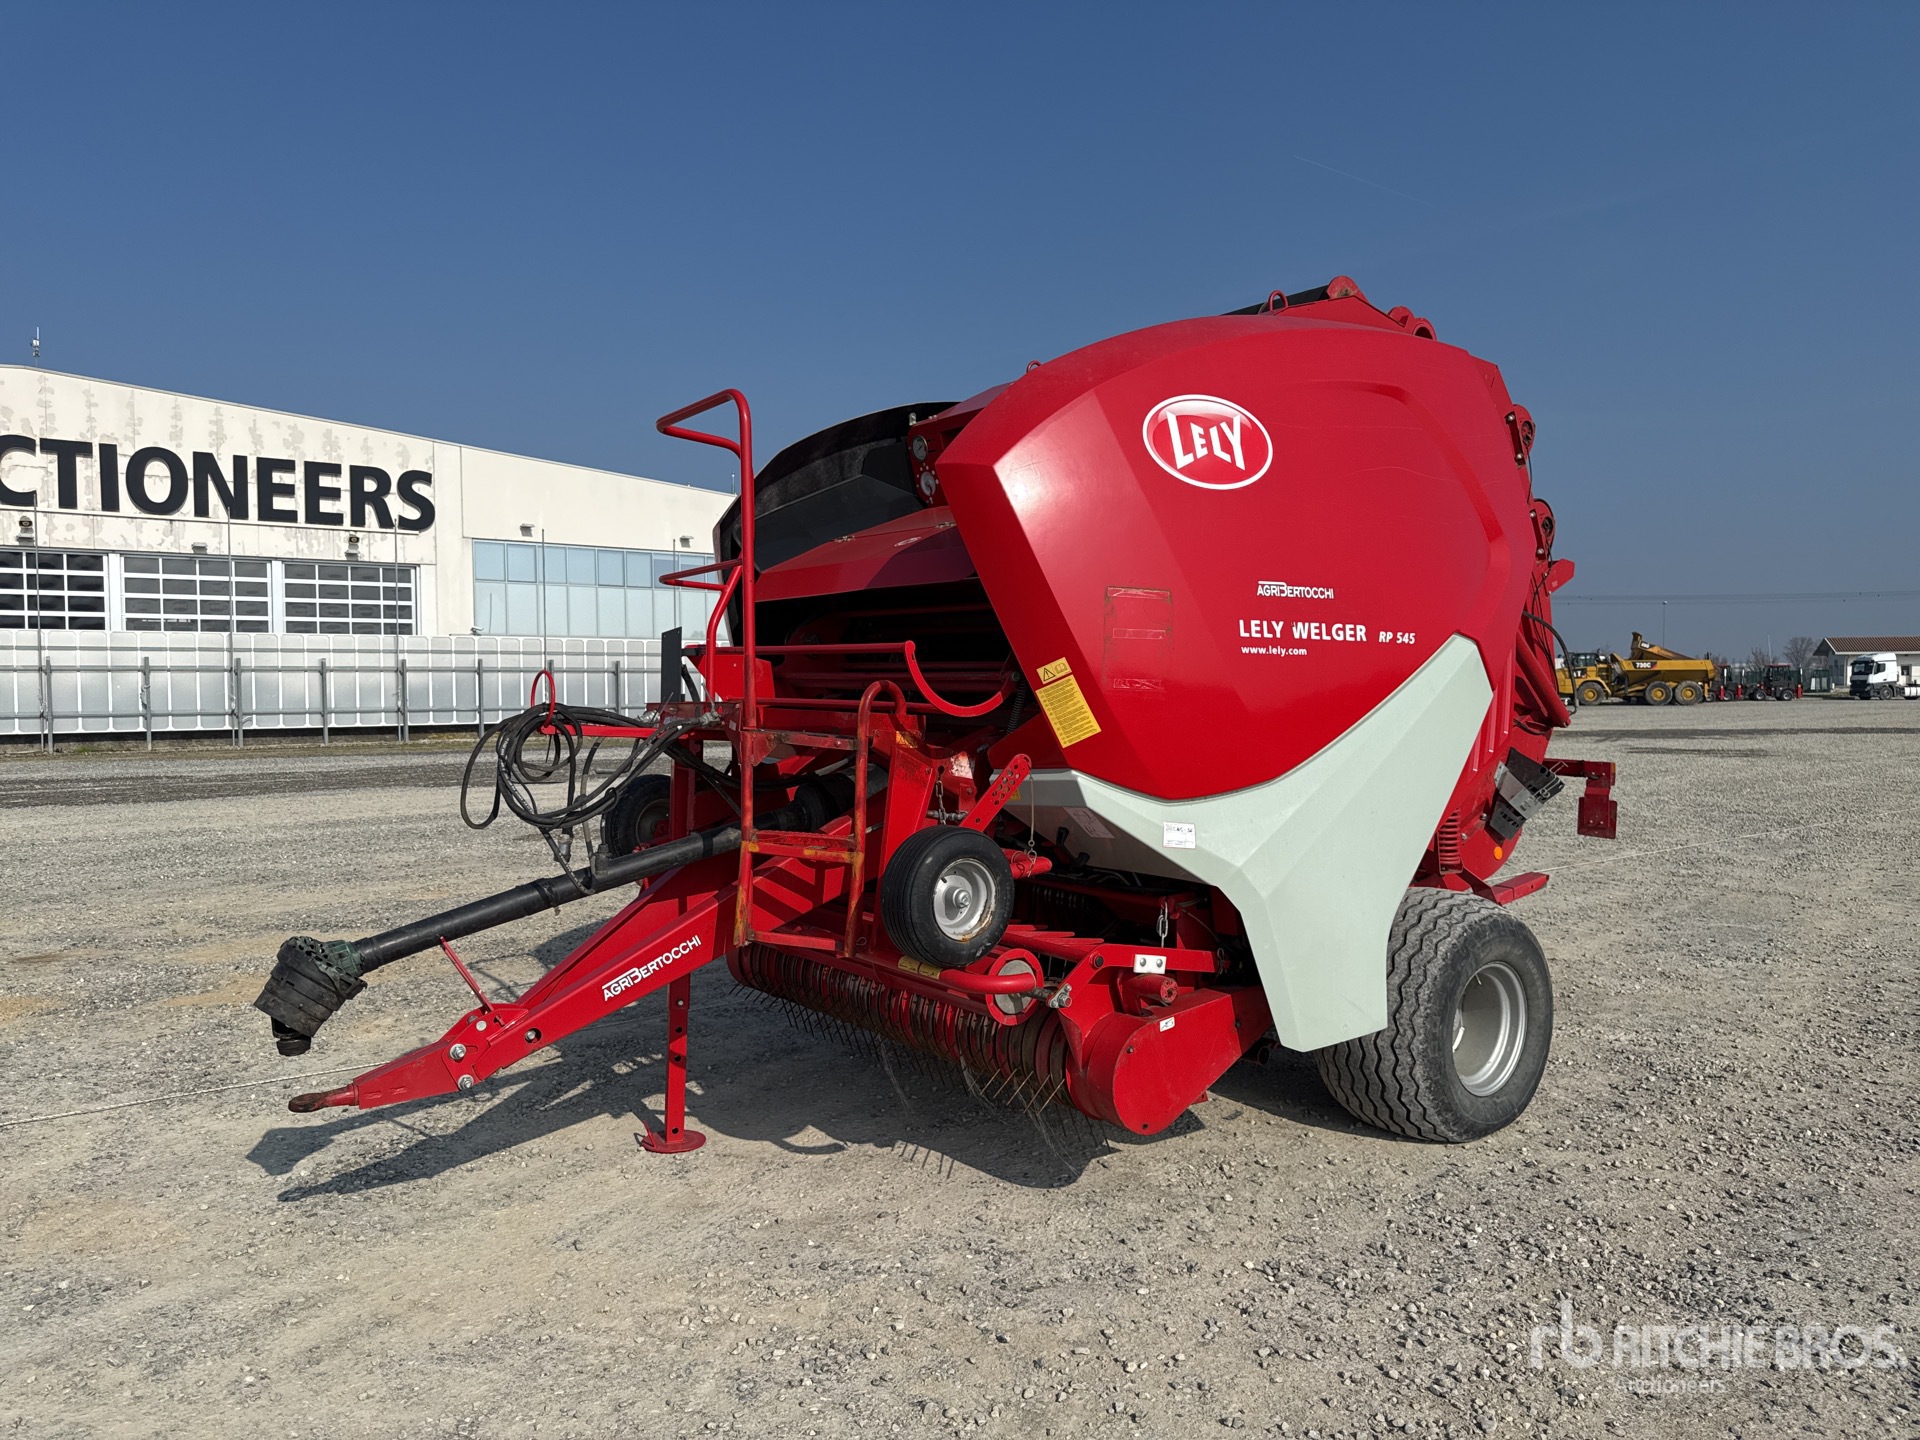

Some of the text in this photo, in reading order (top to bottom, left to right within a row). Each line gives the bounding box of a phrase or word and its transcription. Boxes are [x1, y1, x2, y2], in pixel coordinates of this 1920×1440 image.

[1166, 410, 1246, 471] LELY
[0, 434, 436, 531] CTIONEERS
[1257, 580, 1335, 599] AGRIBERTOCCHI
[1239, 619, 1416, 644] LELY WELGER RP 545
[1241, 645, 1307, 656] www.lely.com
[601, 934, 703, 1002] AGRIBERTOCCHI
